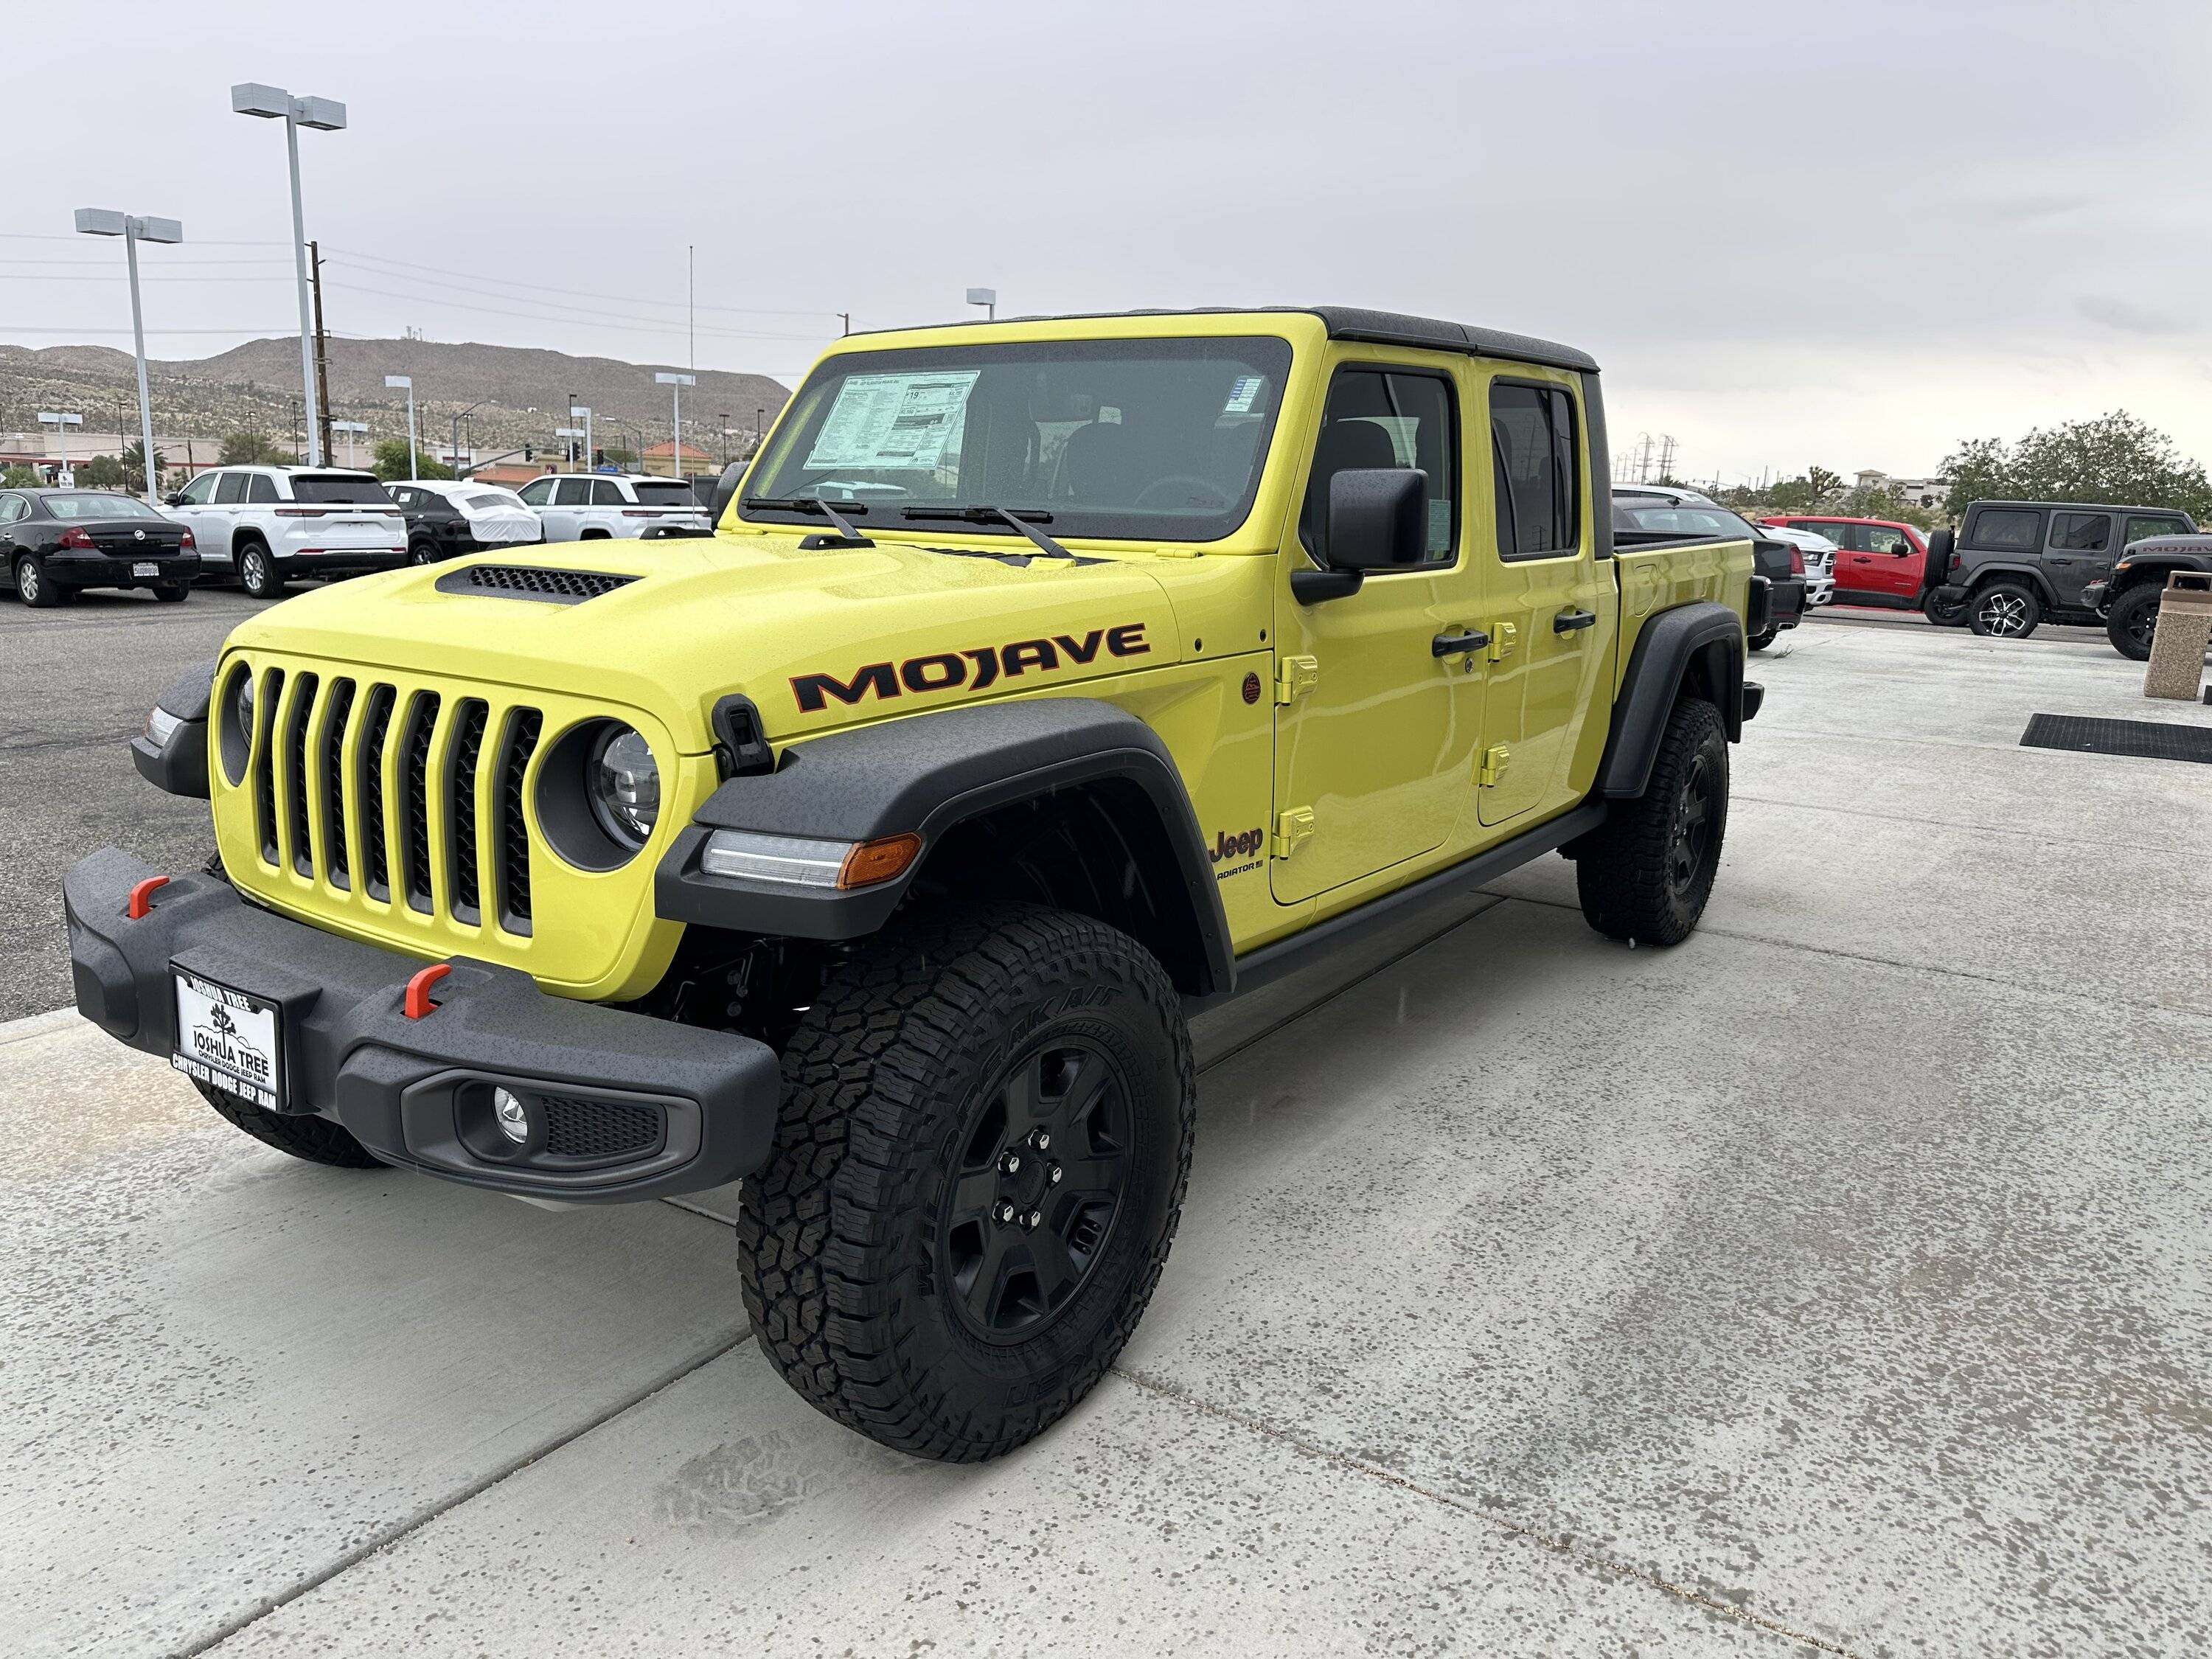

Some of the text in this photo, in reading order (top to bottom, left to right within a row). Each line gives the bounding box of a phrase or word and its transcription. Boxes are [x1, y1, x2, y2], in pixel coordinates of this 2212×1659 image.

[787, 622, 1152, 714] MOJAVE
[1208, 827, 1264, 863] Jeep
[190, 976, 251, 1012] JOSHUA TREE
[193, 1030, 269, 1077] JOSHUA TREE
[198, 1050, 266, 1085] CHRYSLER DODGE JEEP RAM
[172, 1053, 276, 1112] CHRYSLER DODGE JEEP RAM
